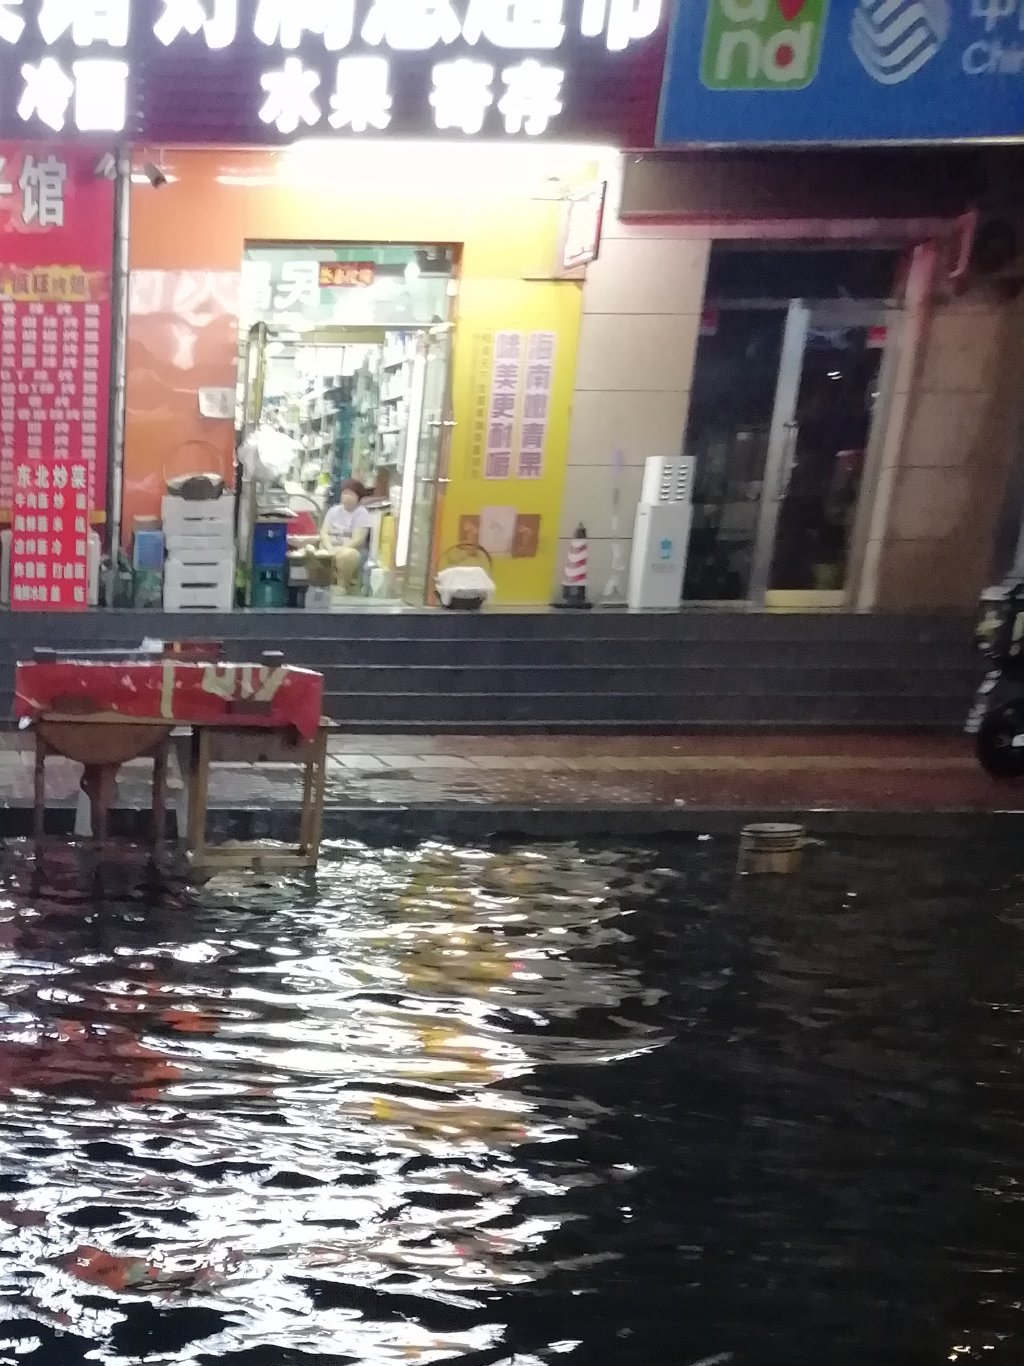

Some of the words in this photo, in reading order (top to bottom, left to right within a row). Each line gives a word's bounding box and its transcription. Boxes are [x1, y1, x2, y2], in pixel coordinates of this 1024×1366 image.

[18, 57, 129, 132] 冷面
[258, 56, 392, 133] 水果
[429, 57, 565, 135] 寄存
[16, 463, 87, 489] 东北炒菜
